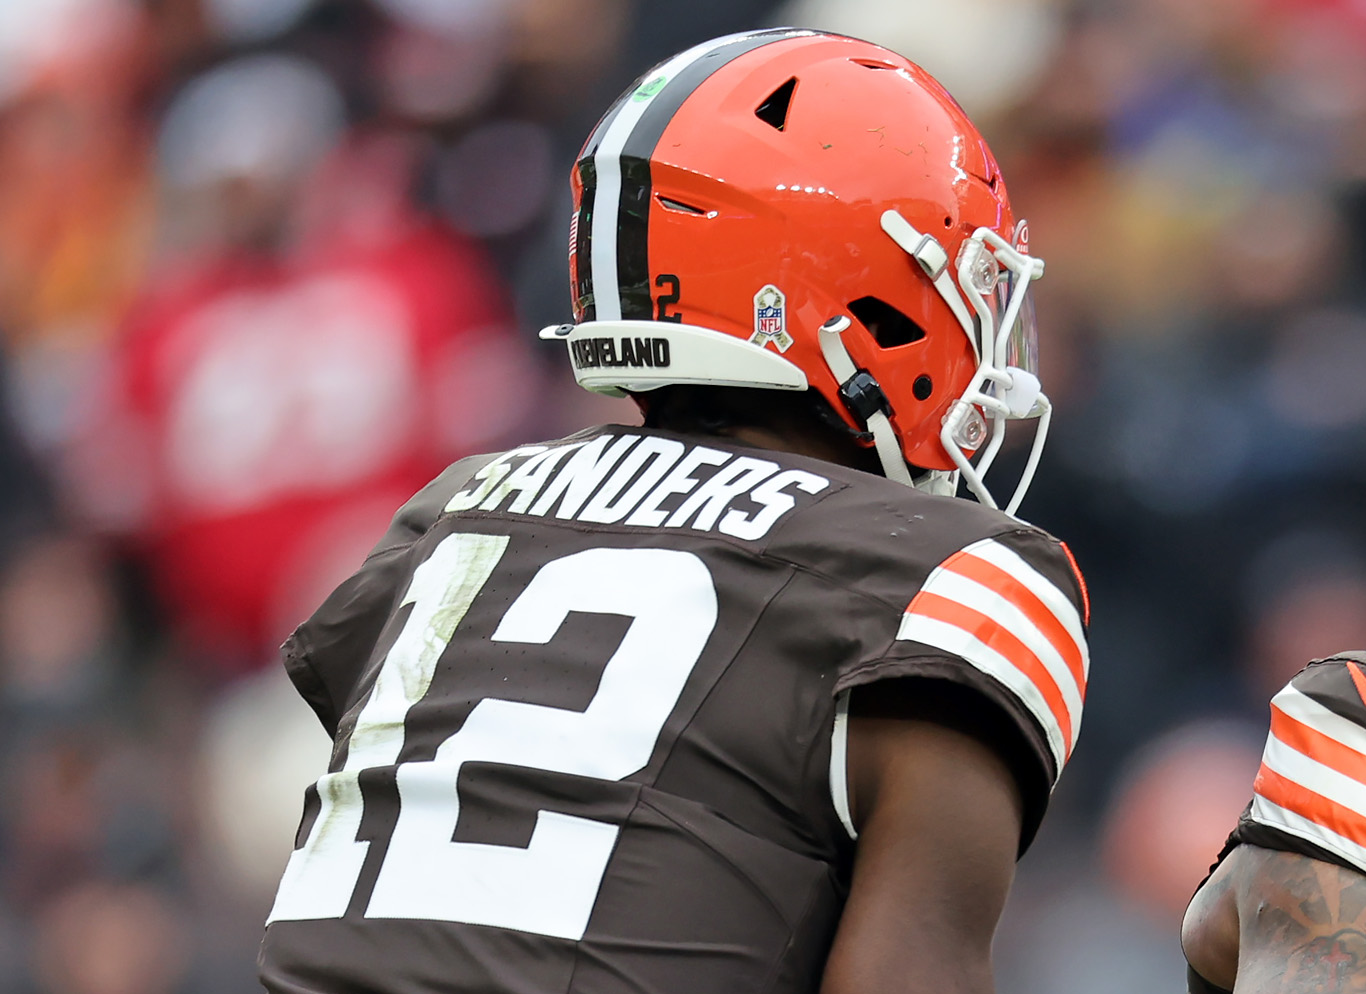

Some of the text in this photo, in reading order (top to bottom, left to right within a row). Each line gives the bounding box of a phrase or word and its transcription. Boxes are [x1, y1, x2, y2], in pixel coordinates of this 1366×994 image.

[656, 274, 682, 324] 2
[760, 318, 781, 333] NFL
[444, 434, 830, 540] SANDERS
[265, 532, 719, 941] 12
